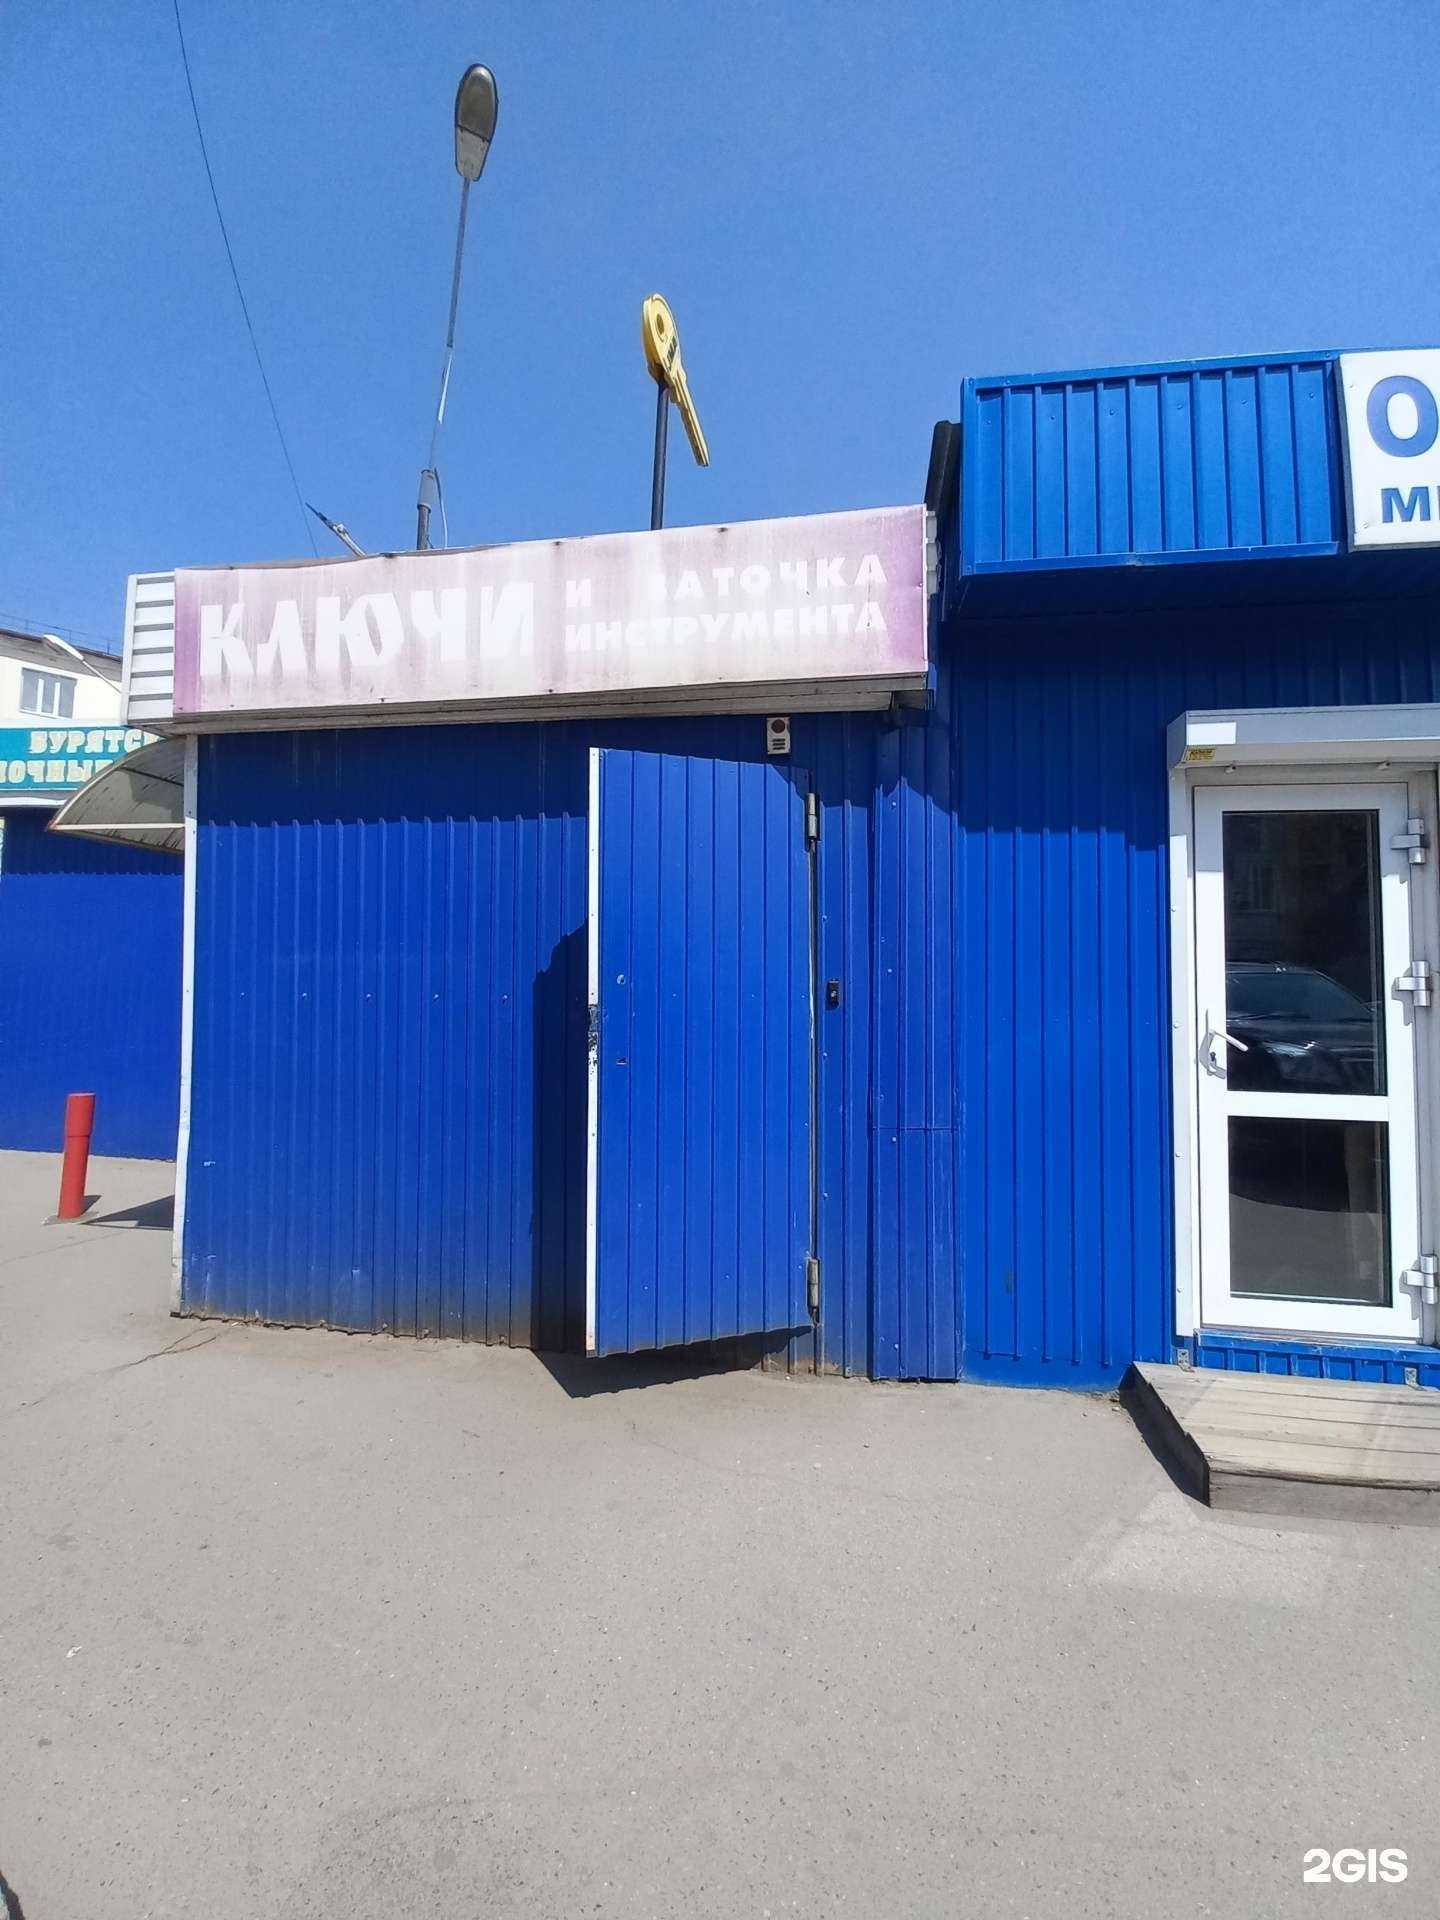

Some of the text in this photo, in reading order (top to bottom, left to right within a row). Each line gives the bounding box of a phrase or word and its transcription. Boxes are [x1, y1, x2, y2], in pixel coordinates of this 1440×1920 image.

[1380, 485, 1440, 524] М
[199, 582, 535, 678] КЛЮЧИ
[565, 578, 592, 608] И
[565, 601, 888, 651] ИНСТРУМЕНТА
